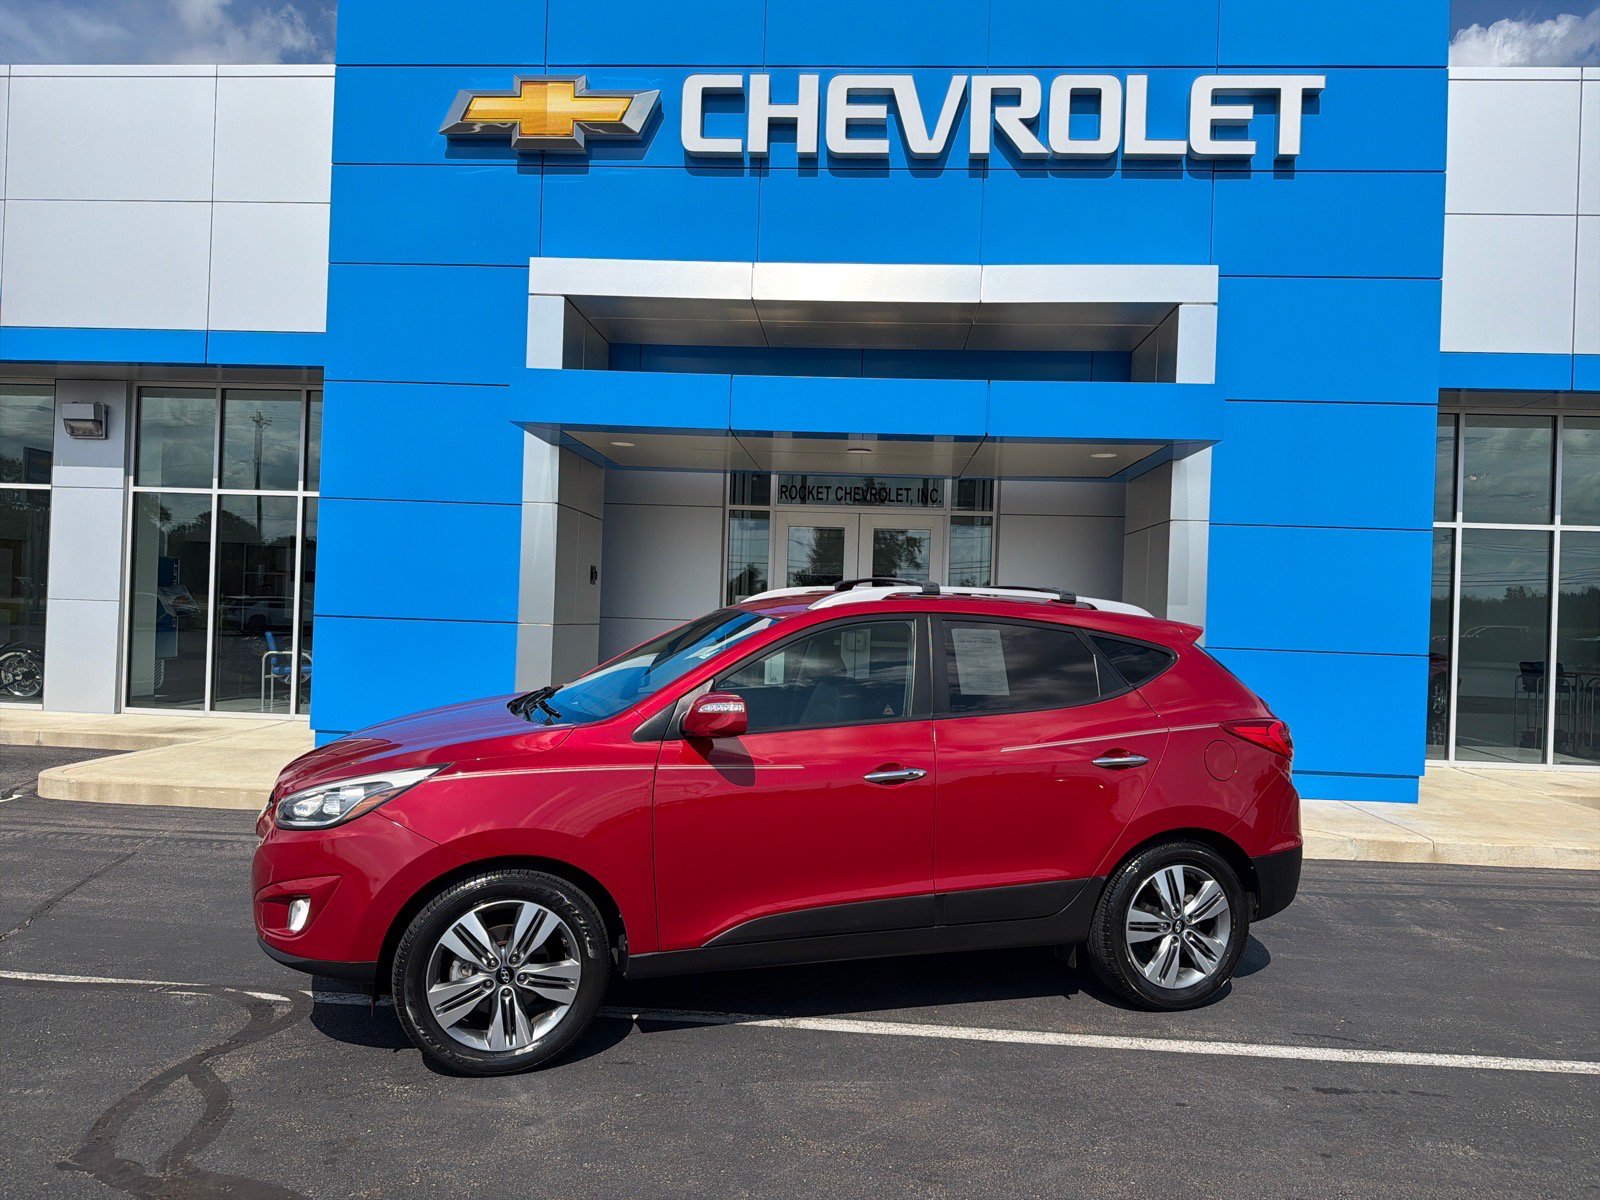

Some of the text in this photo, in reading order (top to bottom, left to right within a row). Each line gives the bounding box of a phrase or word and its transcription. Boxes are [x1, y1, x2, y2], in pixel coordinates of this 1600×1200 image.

[681, 73, 1326, 160] CHEVROLET
[779, 484, 942, 505] ROCKET CHEVROLET, INC.
